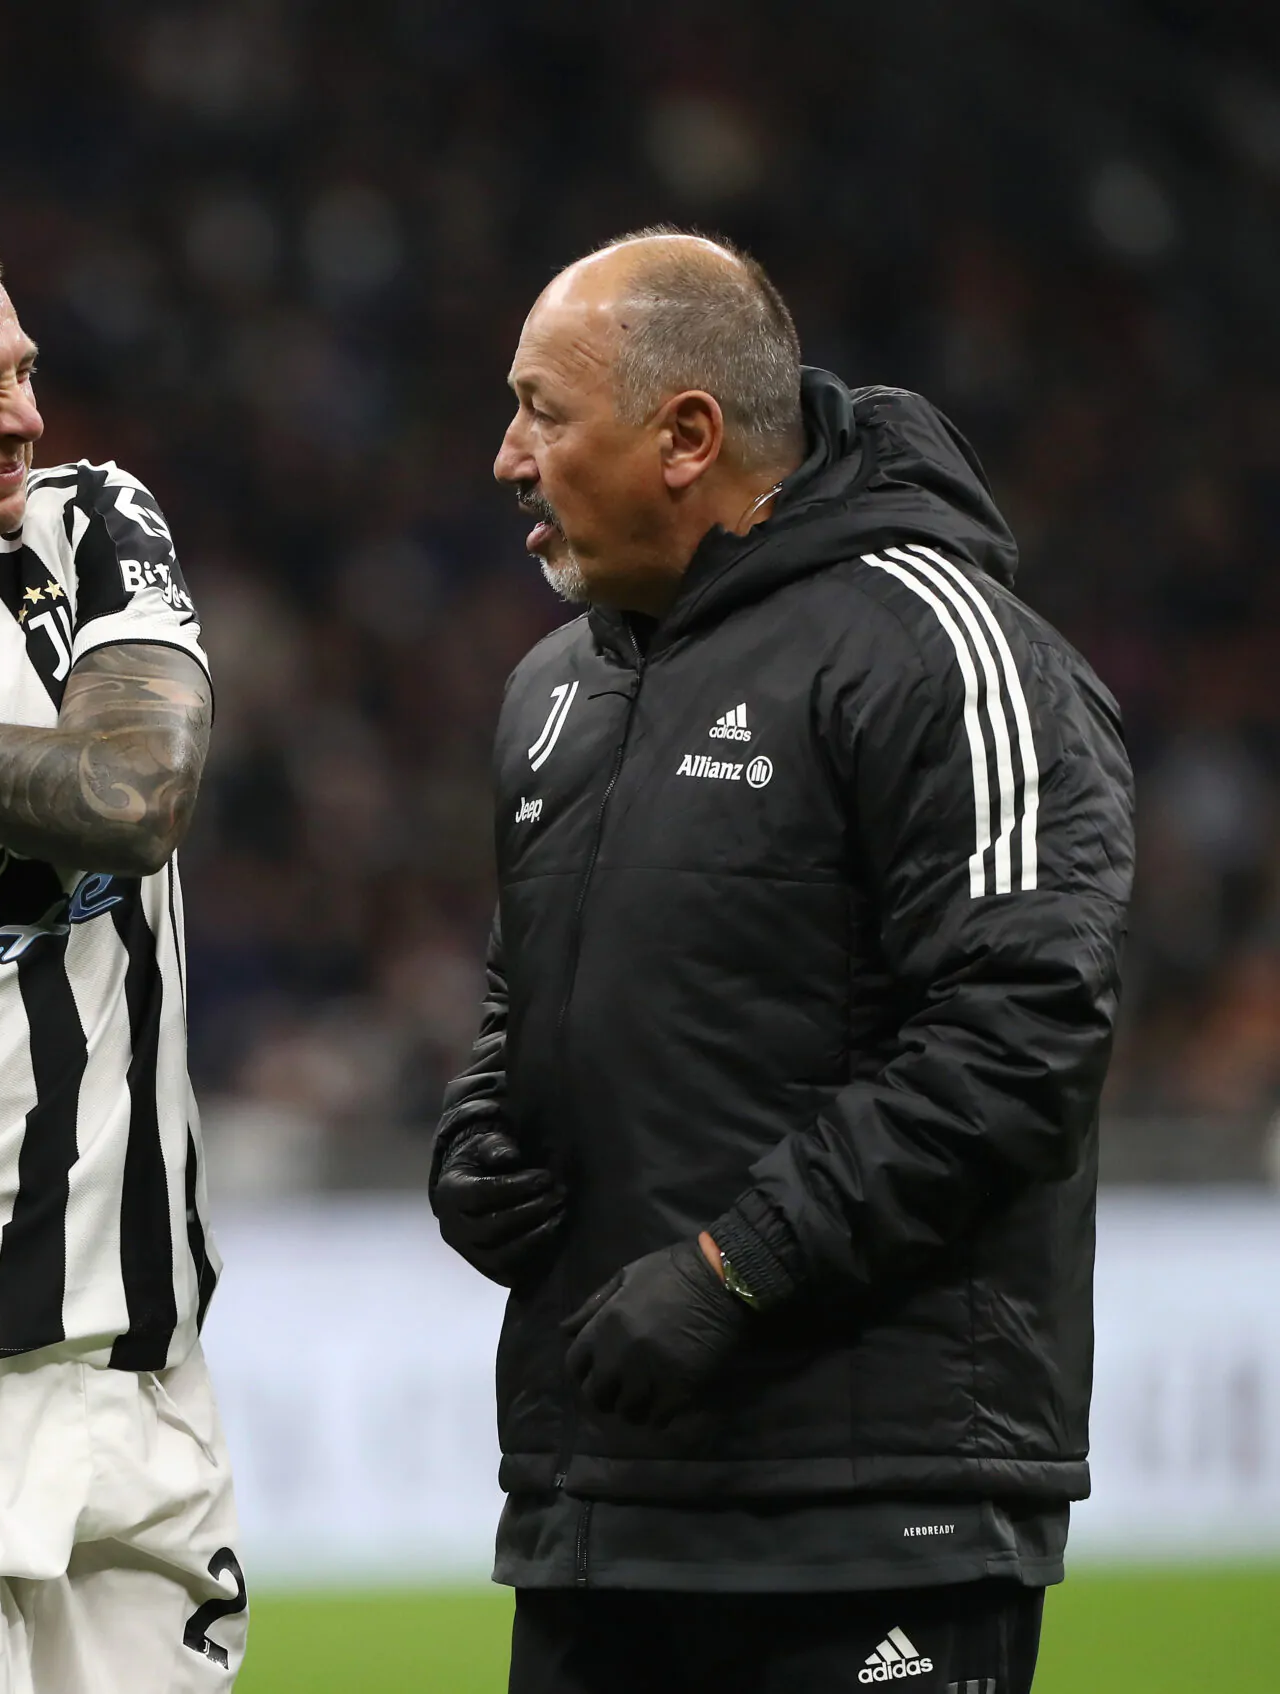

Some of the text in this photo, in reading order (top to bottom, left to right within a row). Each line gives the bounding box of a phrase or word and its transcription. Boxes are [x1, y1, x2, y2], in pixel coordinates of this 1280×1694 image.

[708, 724, 752, 742] adidas
[675, 754, 744, 780] Allianz
[515, 796, 543, 823] Jeep
[903, 1524, 955, 1537] AEROREADY
[857, 1656, 934, 1684] adidas
